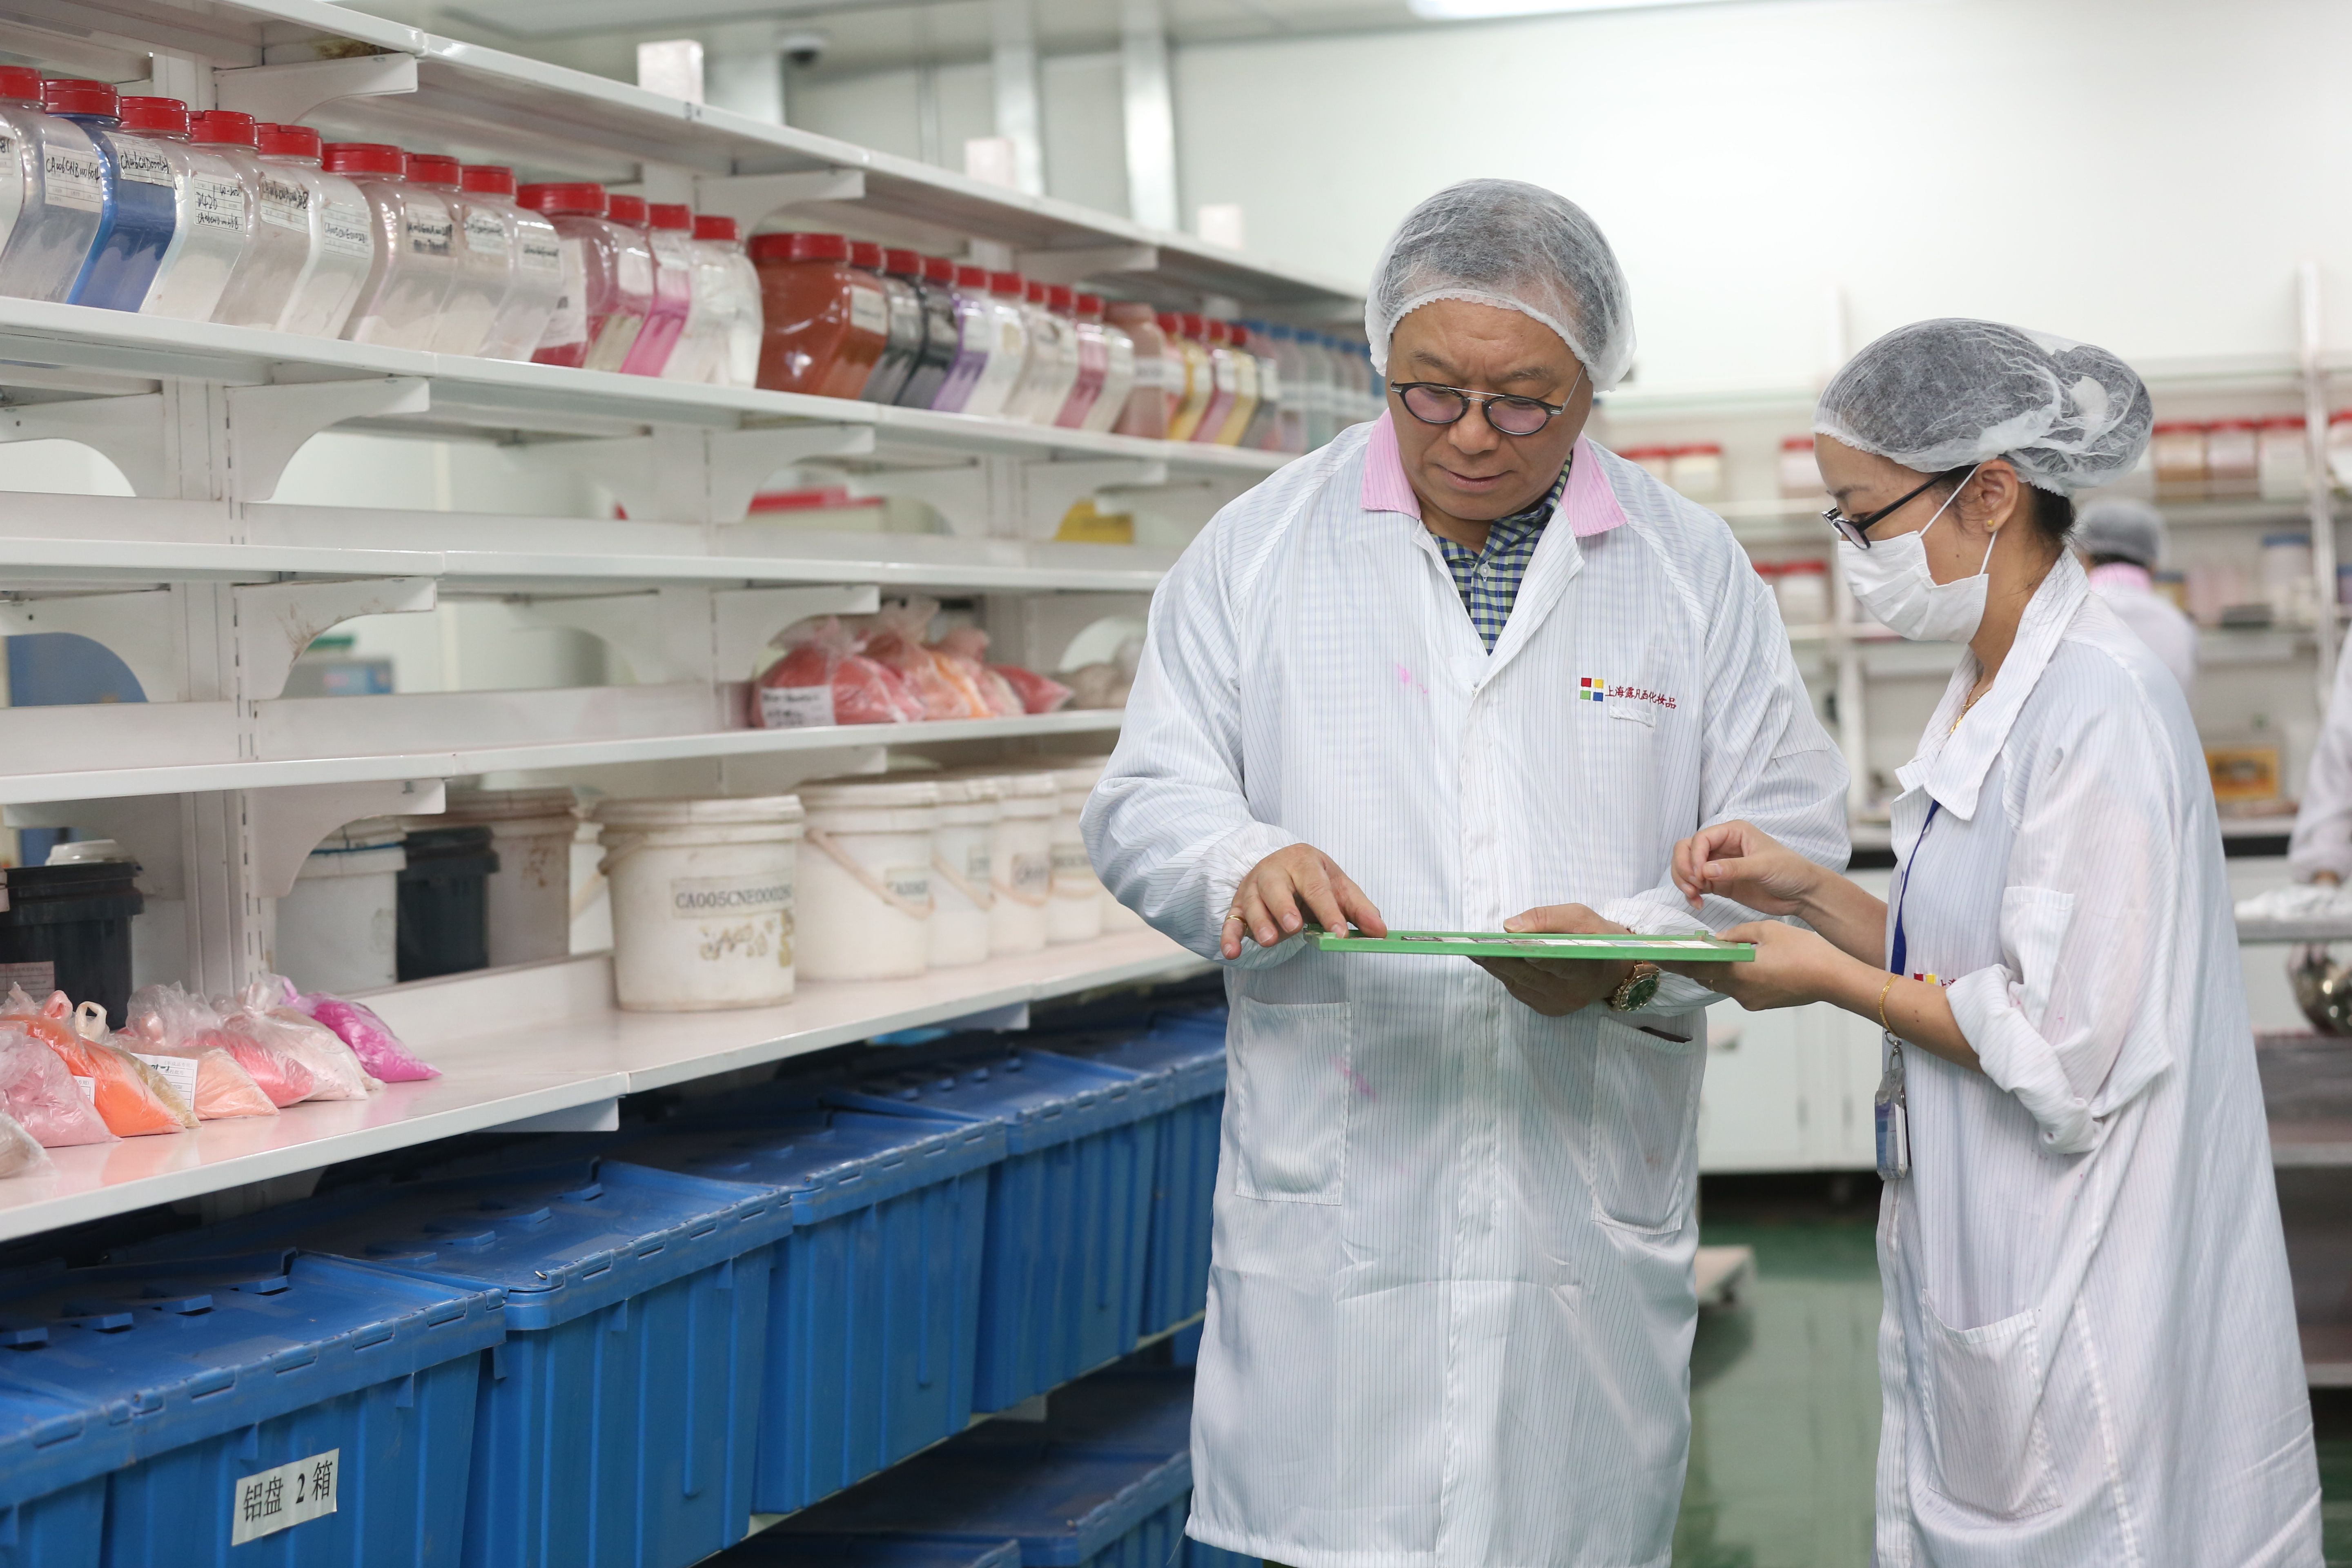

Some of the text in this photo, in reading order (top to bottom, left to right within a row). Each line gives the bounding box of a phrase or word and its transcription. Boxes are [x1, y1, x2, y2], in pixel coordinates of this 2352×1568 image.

[244, 1460, 333, 1522] 铝盘 2 箱
